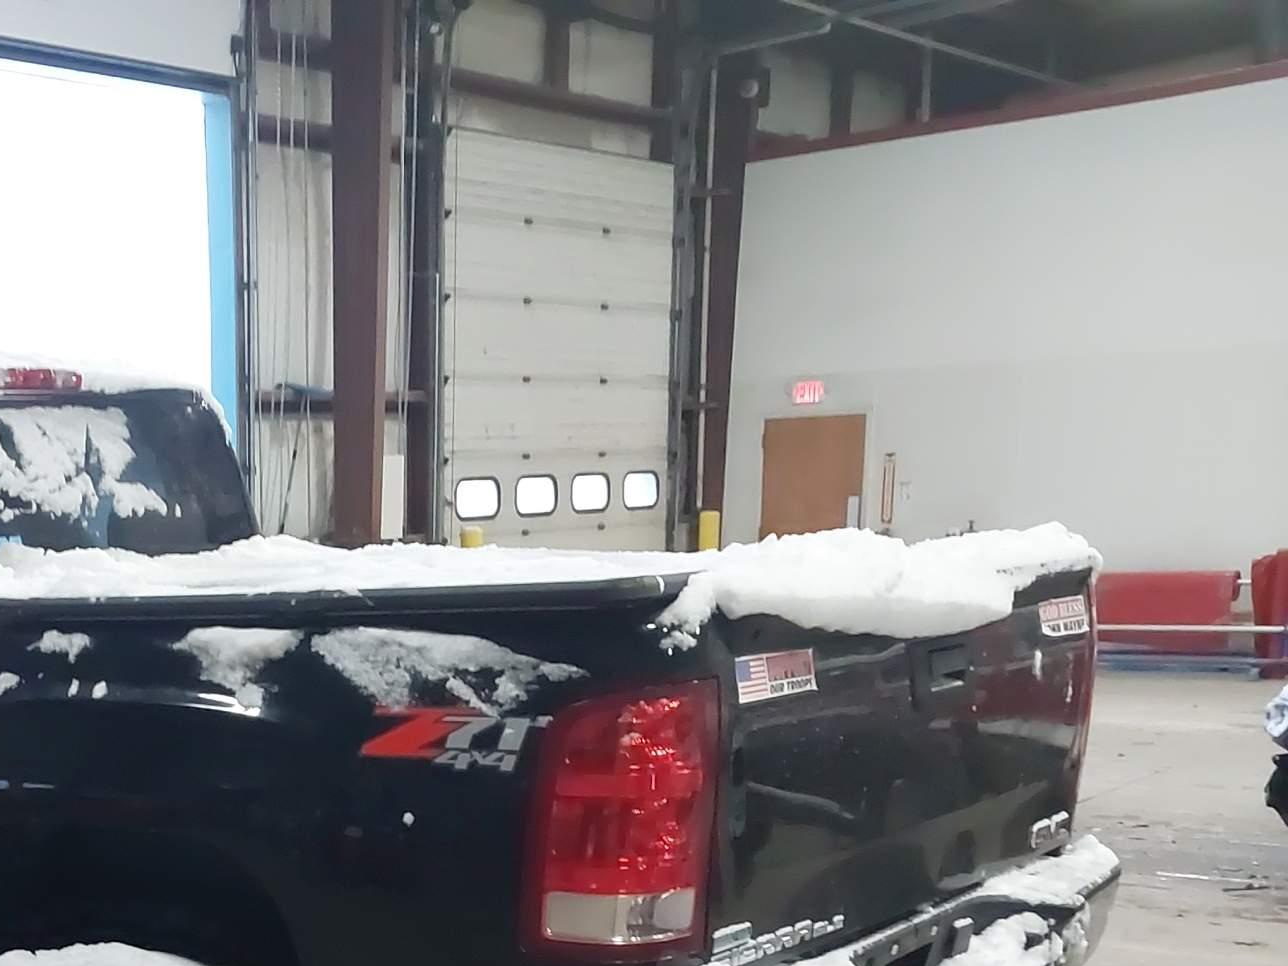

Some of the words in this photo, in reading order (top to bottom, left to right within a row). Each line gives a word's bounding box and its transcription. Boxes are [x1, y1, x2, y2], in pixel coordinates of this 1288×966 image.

[795, 381, 819, 404] EXIT
[1040, 604, 1058, 621] GOD
[1060, 601, 1083, 616] BLESS
[769, 682, 785, 695] OUR
[359, 706, 532, 762] Z71
